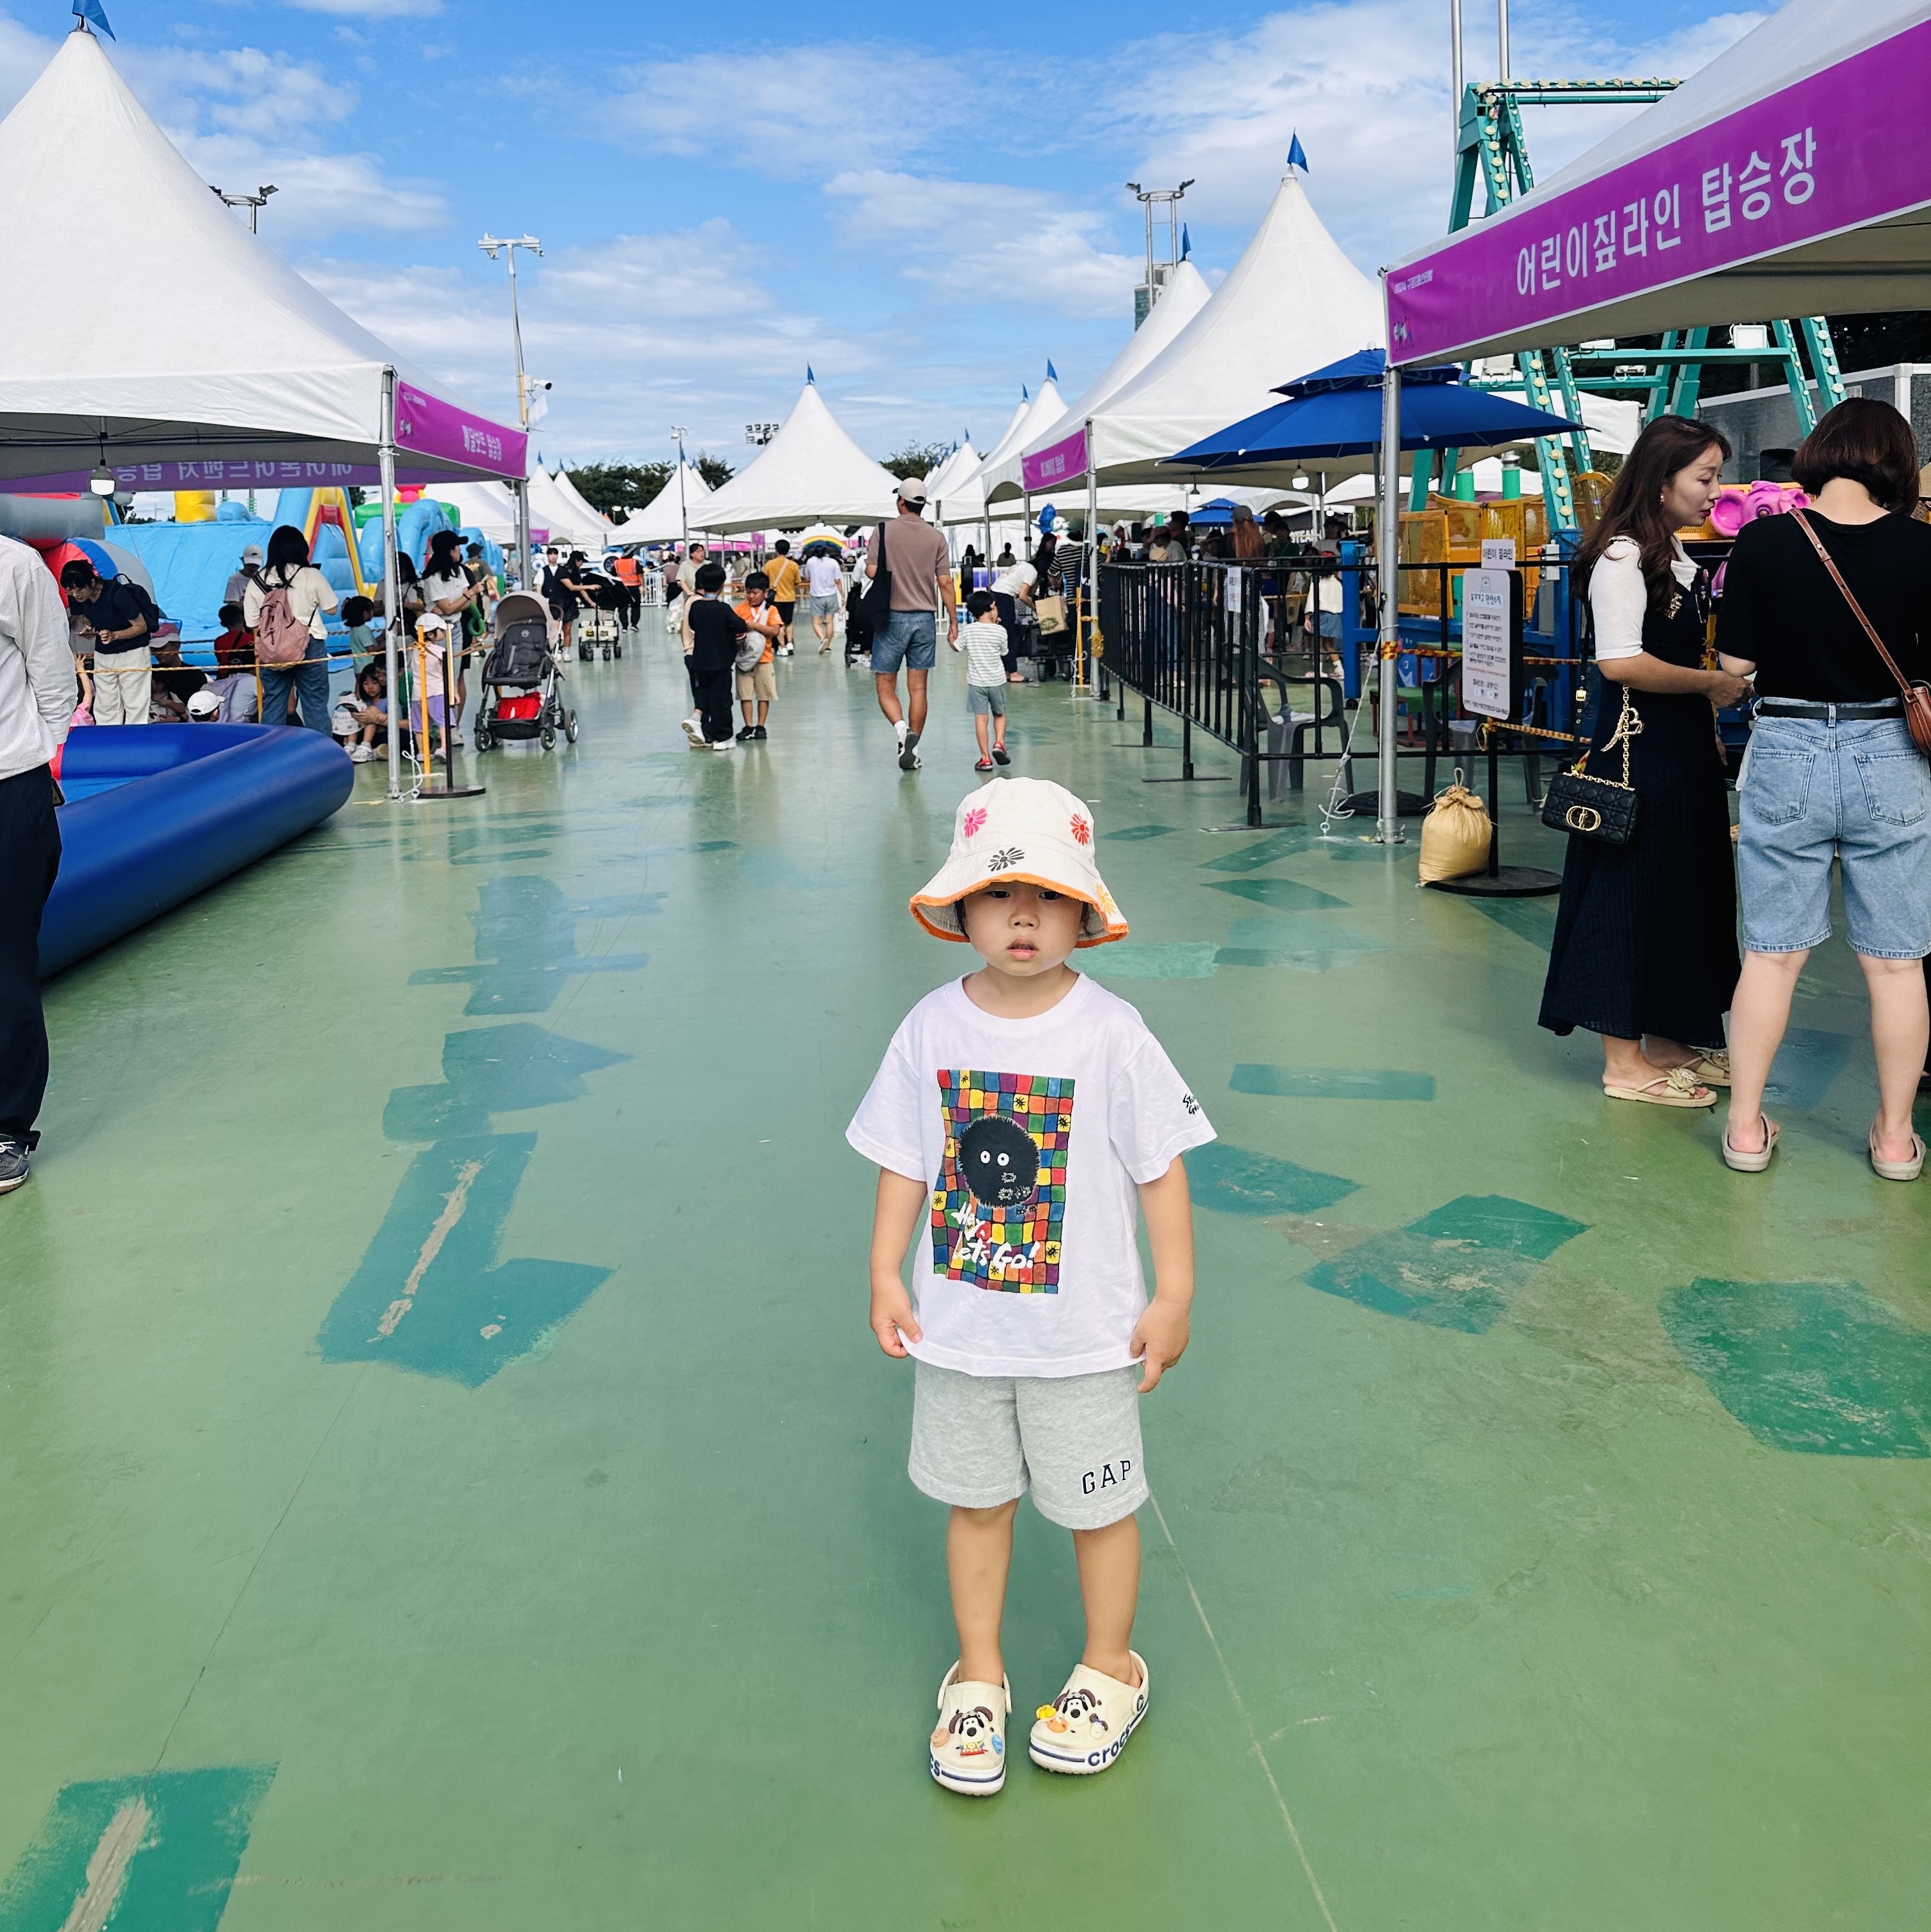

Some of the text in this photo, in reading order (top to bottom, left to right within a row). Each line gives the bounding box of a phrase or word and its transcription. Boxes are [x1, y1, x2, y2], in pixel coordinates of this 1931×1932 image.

[1702, 126, 1817, 234] 탑승장
[992, 1241, 1041, 1274] Go!
[1082, 1460, 1131, 1495] GAP
[1088, 1723, 1131, 1767] crocs
